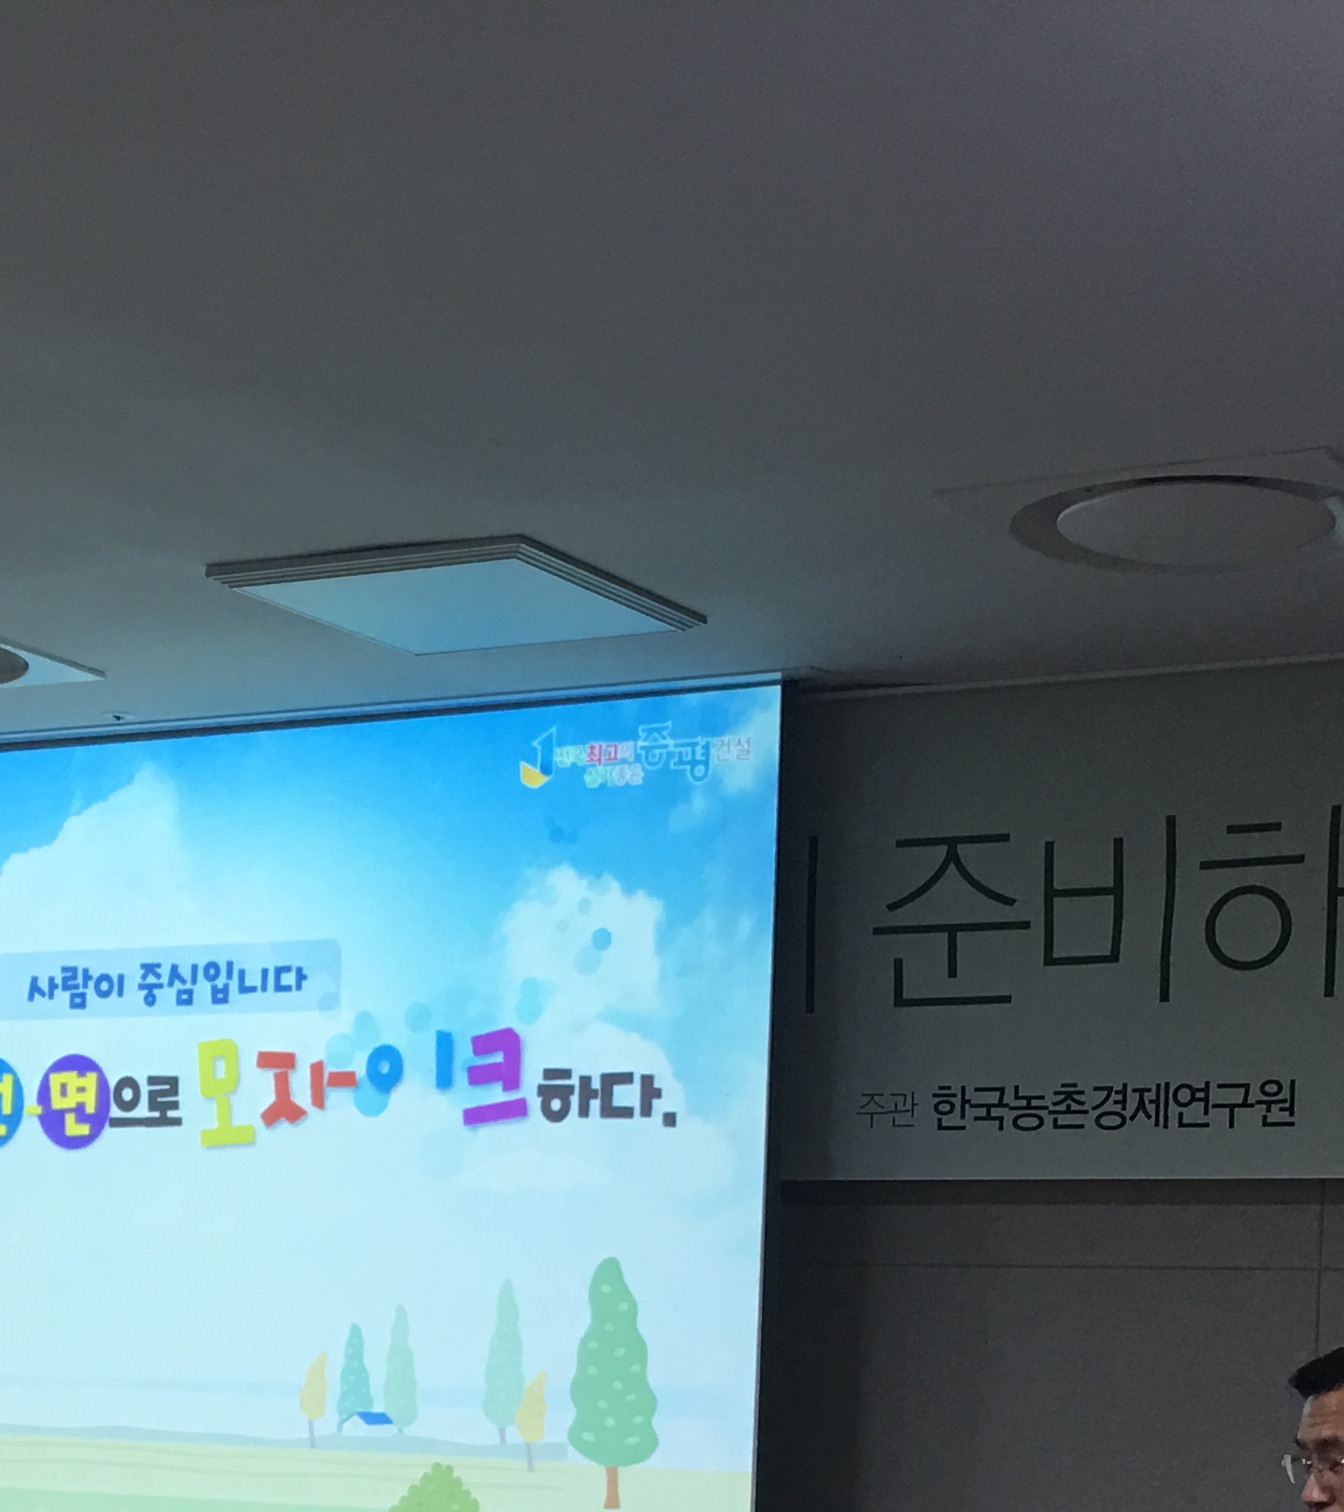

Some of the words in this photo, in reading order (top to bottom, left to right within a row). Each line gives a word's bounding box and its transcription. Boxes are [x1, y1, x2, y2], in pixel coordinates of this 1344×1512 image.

[27, 964, 125, 1010] 사람이
[137, 959, 308, 1007] 중심입니다
[856, 1088, 918, 1129] 주관
[932, 1077, 1297, 1132] 한국농촌경제연구원
